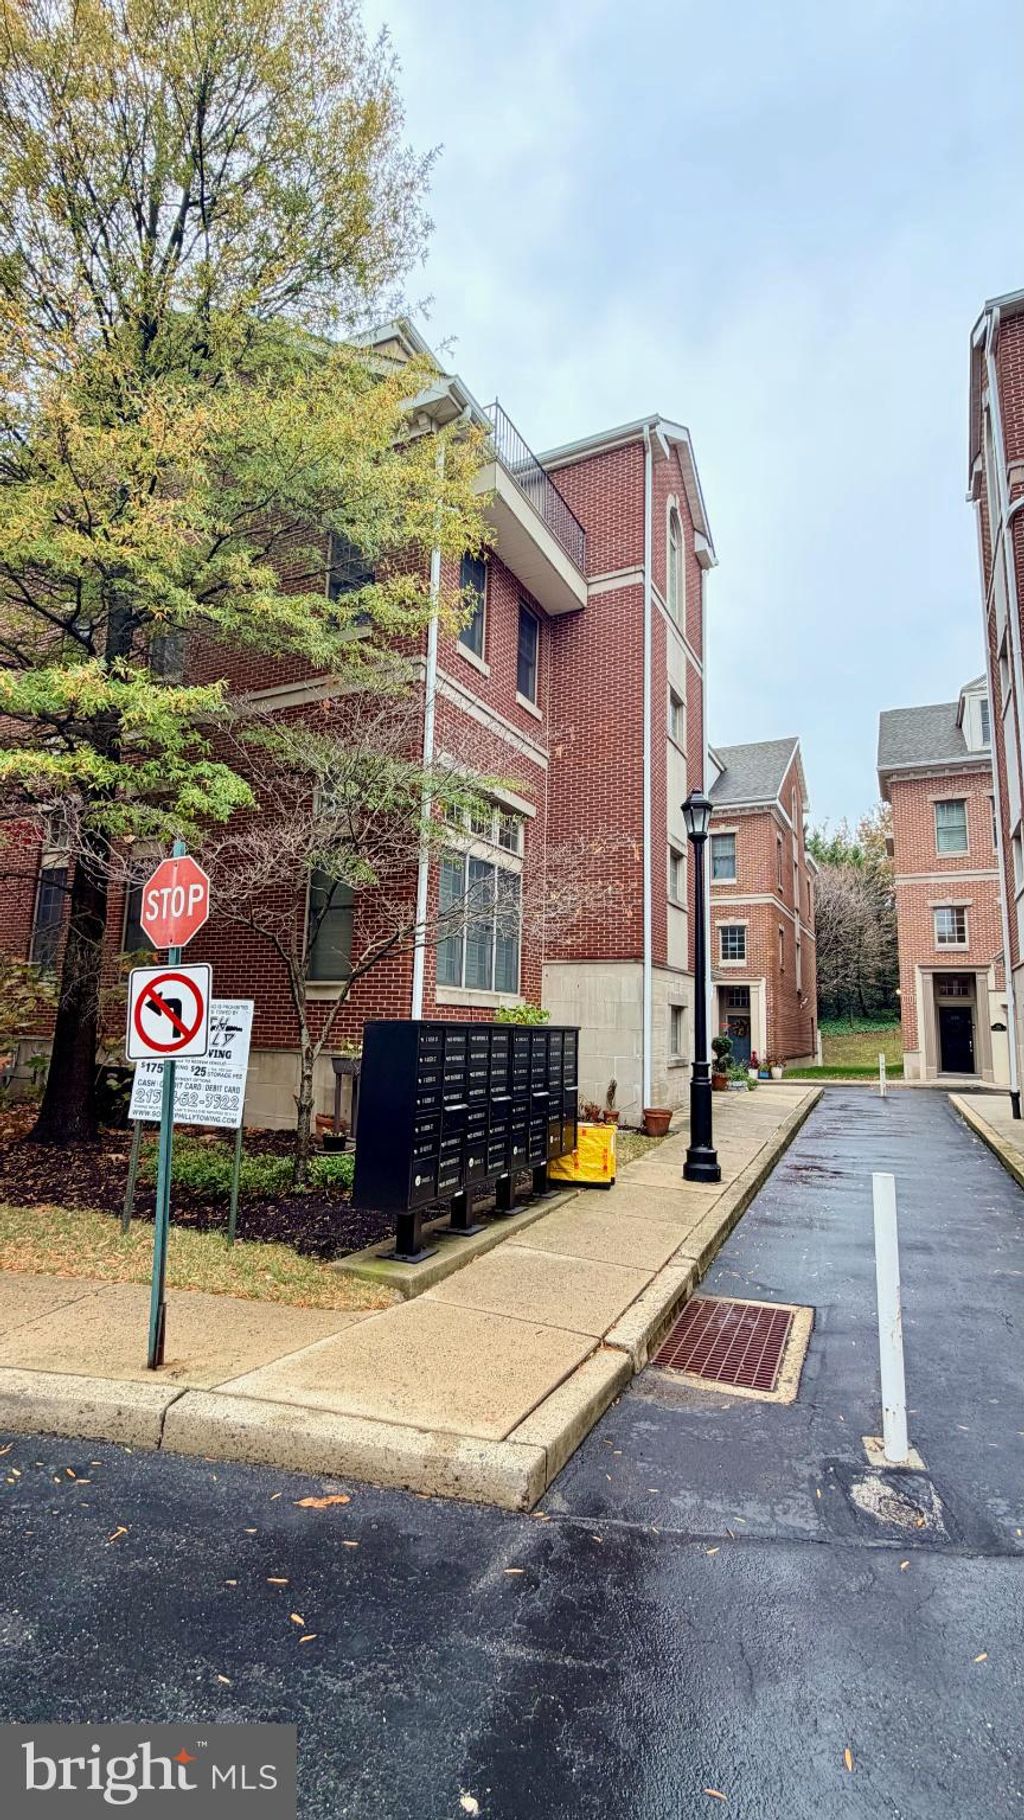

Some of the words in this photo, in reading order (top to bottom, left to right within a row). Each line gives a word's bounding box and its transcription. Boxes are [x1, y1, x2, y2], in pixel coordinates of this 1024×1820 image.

[145, 884, 204, 921] STOP
[141, 1062, 164, 1074] $175
[190, 1065, 207, 1077] $25
[137, 1079, 156, 1087] CASH
[204, 1084, 222, 1092] DEBIT
[224, 1085, 241, 1094] CARD
